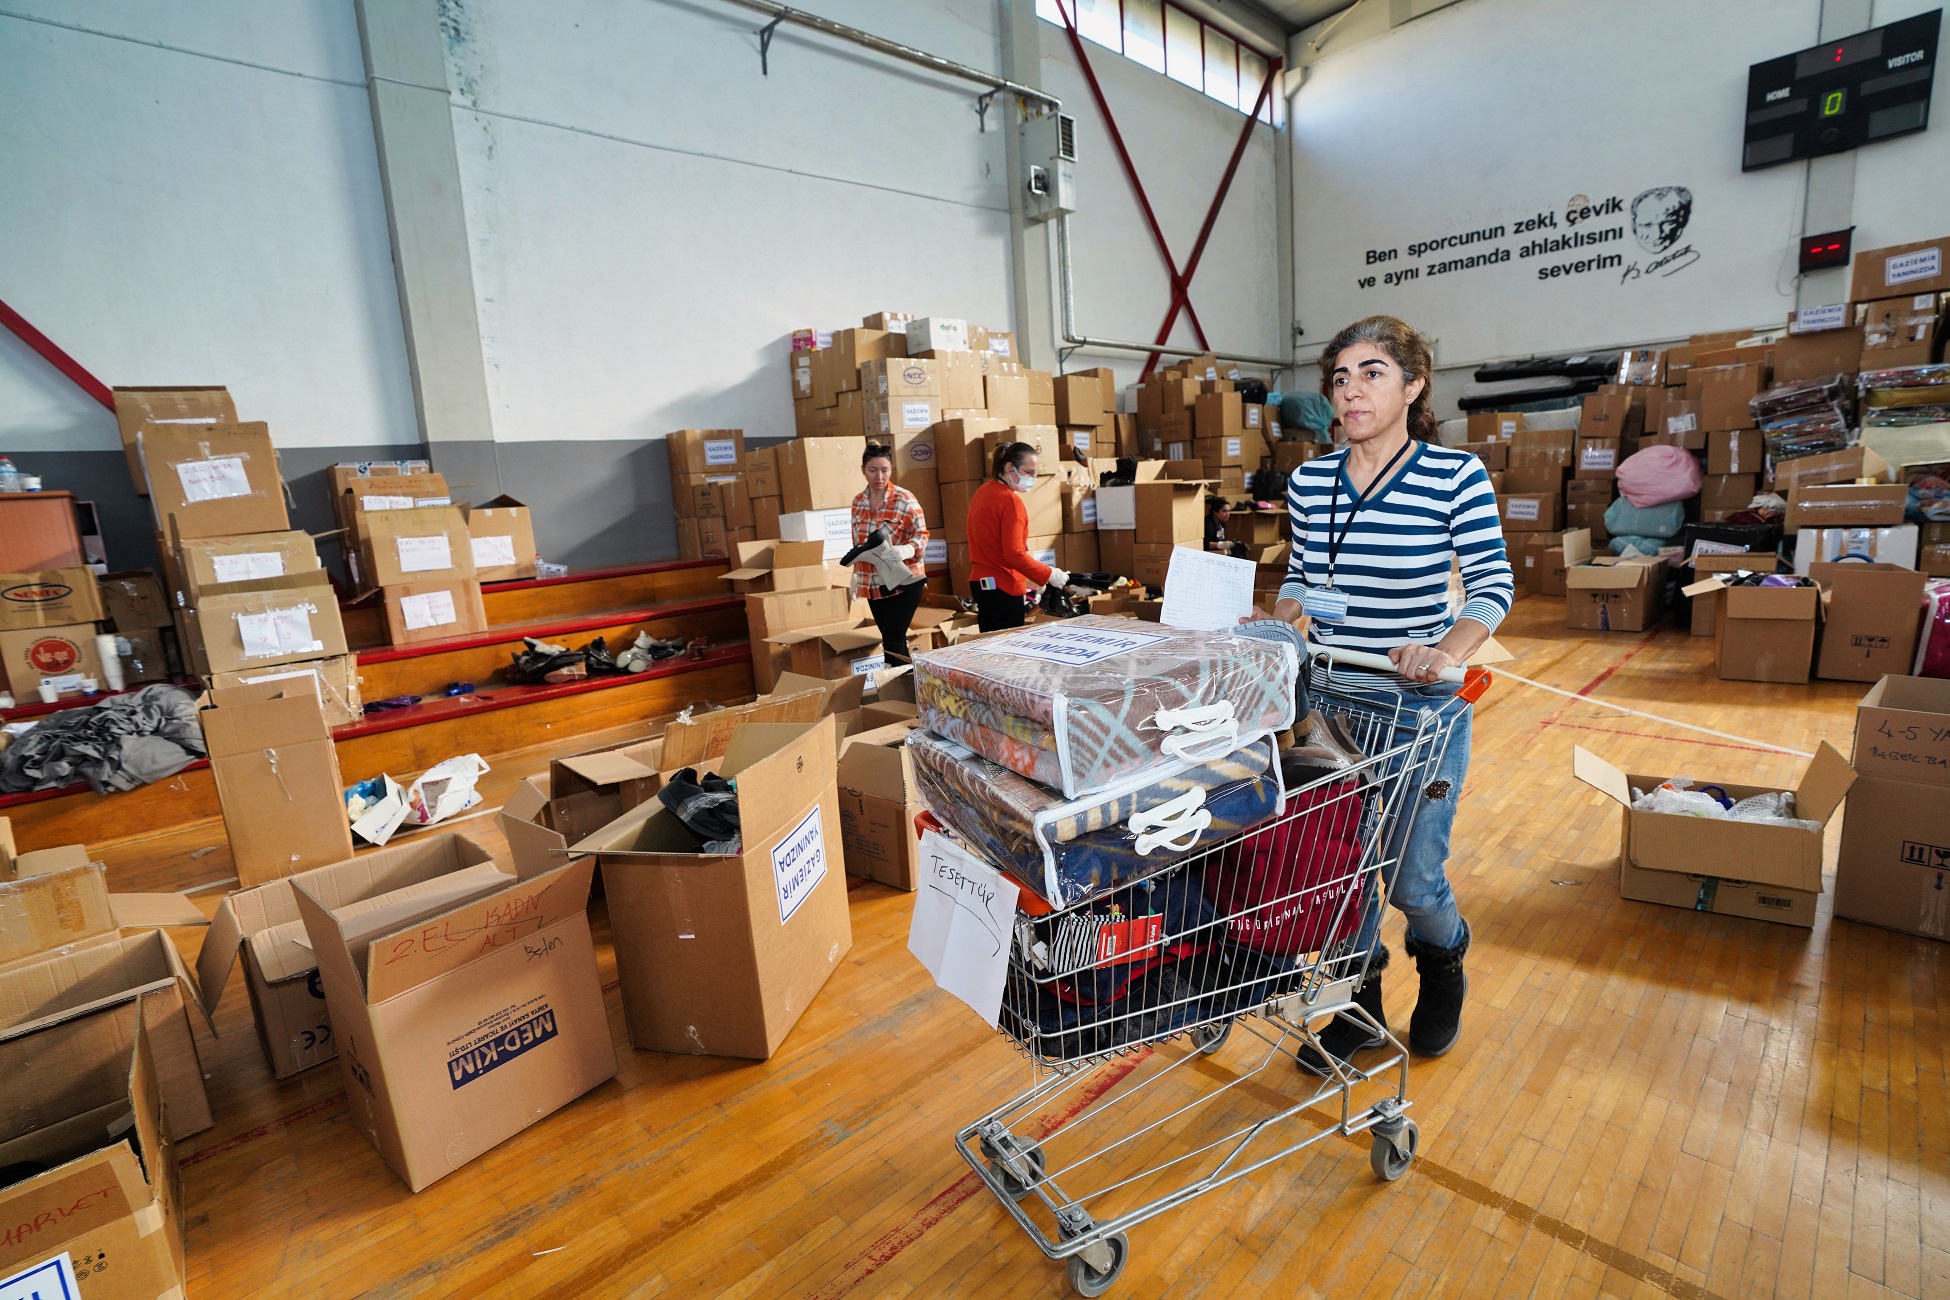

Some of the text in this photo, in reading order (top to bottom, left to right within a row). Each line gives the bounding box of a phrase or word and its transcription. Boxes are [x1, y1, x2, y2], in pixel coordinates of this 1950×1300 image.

[1887, 50, 1924, 69] VISITOR
[1766, 87, 1790, 103] HOME
[1824, 92, 1842, 115] 0
[1366, 249, 1398, 265] Ben
[1407, 224, 1505, 258] sporcunun
[1514, 211, 1557, 235] zeki,
[1565, 196, 1624, 227] çevik
[1358, 226, 1624, 289] ve aynı zamanda ahlaklısını
[1538, 253, 1622, 281] severim
[1892, 254, 1937, 270] GAZİEMİR
[1892, 264, 1936, 279] YANINIZDA
[1029, 630, 1138, 648] GAZİEMİR
[1878, 720, 1950, 742] 4-5 YA
[779, 823, 819, 873] YANINIZDA
[782, 848, 821, 900] GAZİEMİR
[530, 1002, 549, 1016] KİMYA
[499, 1024, 508, 1032] VE
[508, 1012, 530, 1029] SANAYİ
[451, 1010, 554, 1082] MED-KİM
